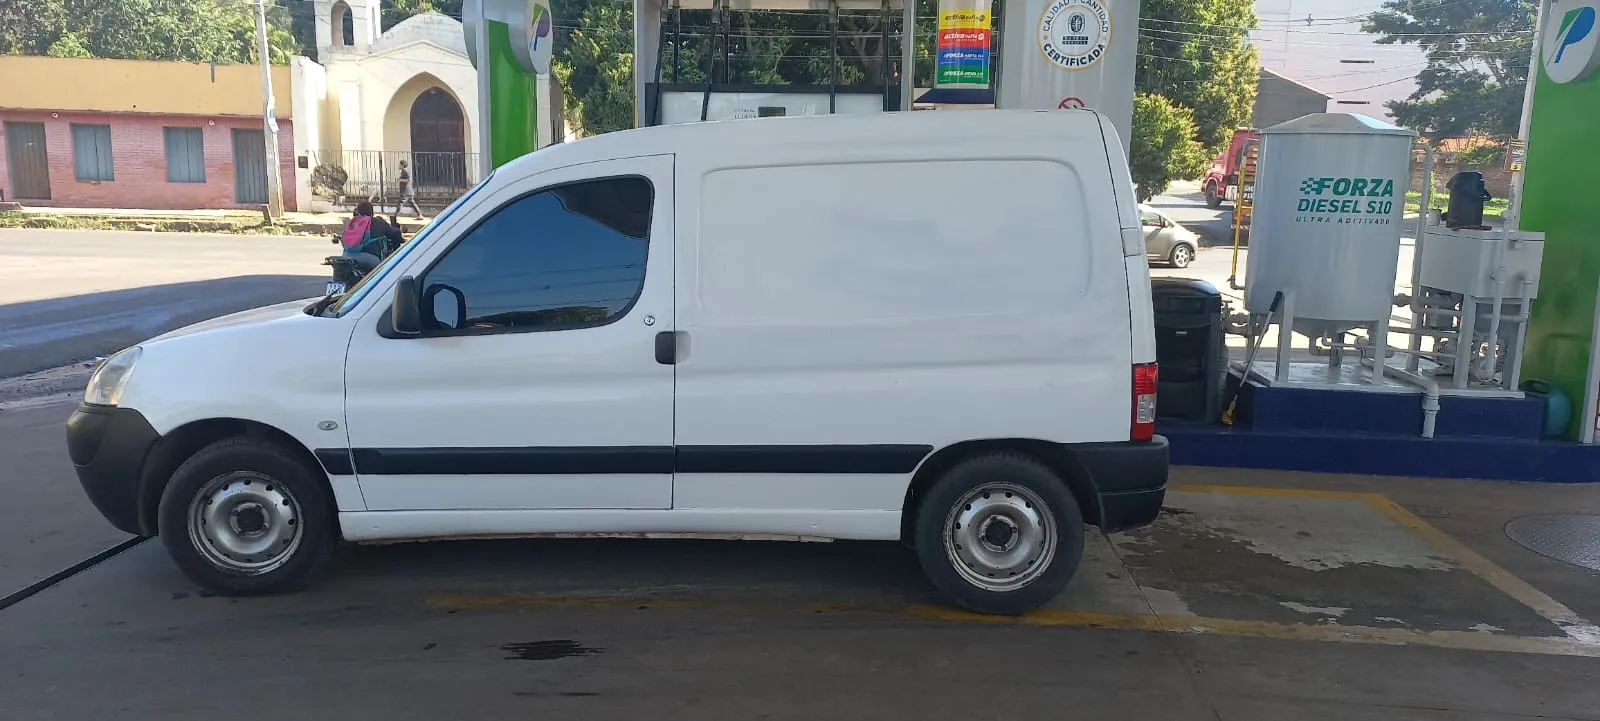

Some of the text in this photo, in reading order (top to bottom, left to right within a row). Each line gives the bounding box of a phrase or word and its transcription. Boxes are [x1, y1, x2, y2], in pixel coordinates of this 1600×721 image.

[1043, 0, 1070, 31] CALIDAD
[1043, 43, 1105, 66] CERTIFICADA
[1316, 177, 1394, 197] FORZA
[1297, 199, 1392, 214] DIESEL S10
